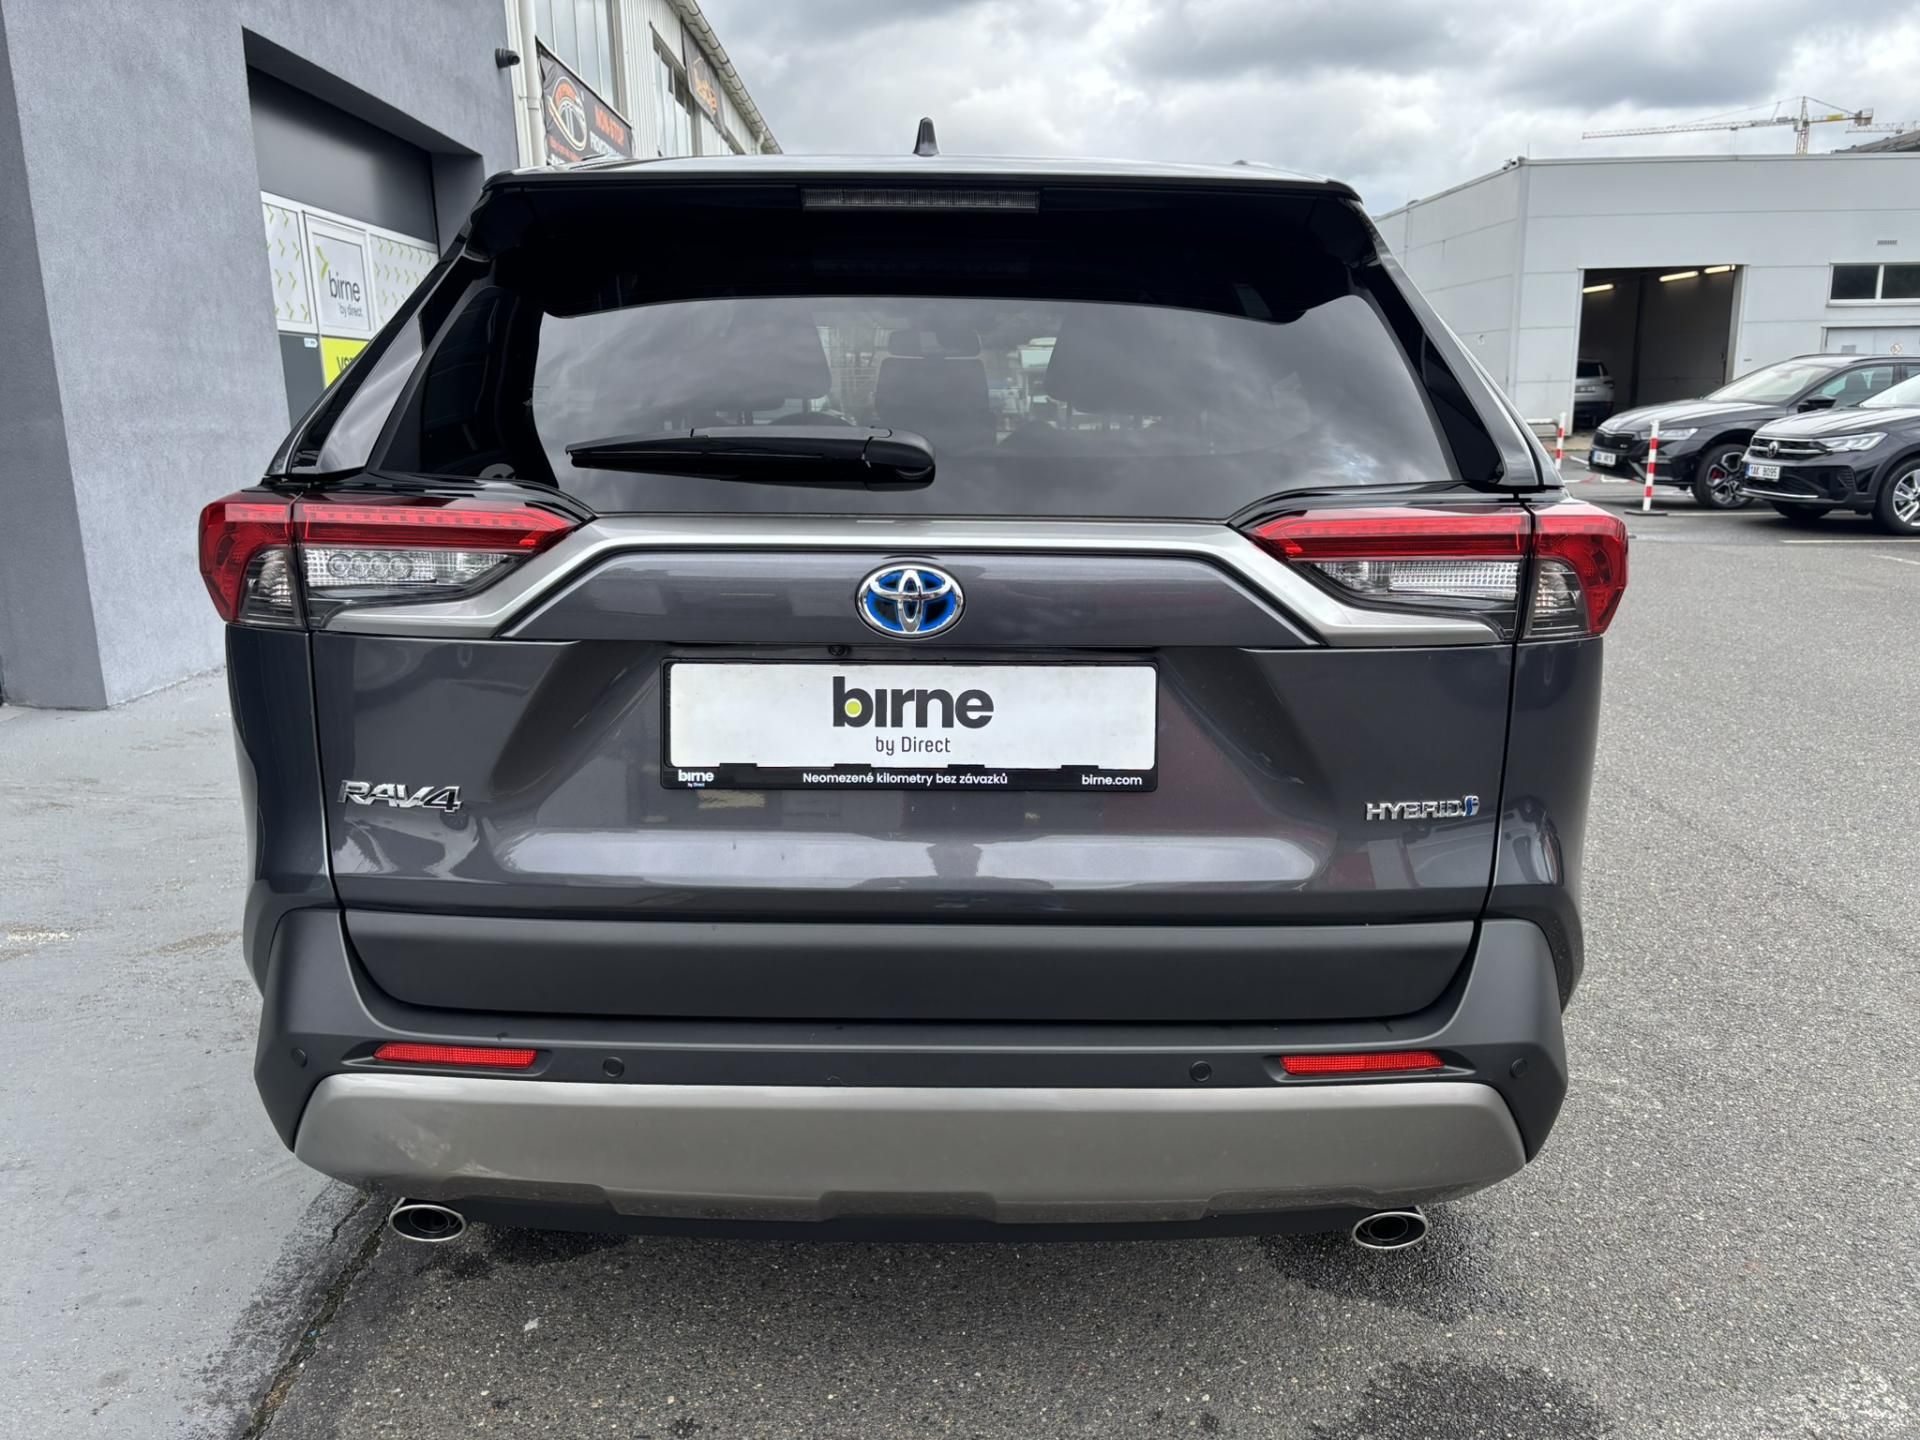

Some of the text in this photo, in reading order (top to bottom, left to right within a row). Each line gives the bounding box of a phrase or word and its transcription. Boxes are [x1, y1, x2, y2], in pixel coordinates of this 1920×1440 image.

[328, 270, 360, 302] birne
[833, 676, 994, 728] birne
[875, 736, 951, 756] by Direct
[678, 769, 715, 782] birne
[803, 773, 1008, 787] Neomezené kilometry bez závazků
[1081, 774, 1142, 785] birne.com
[338, 780, 462, 812] RAV4
[1366, 800, 1462, 820] HYBRID
